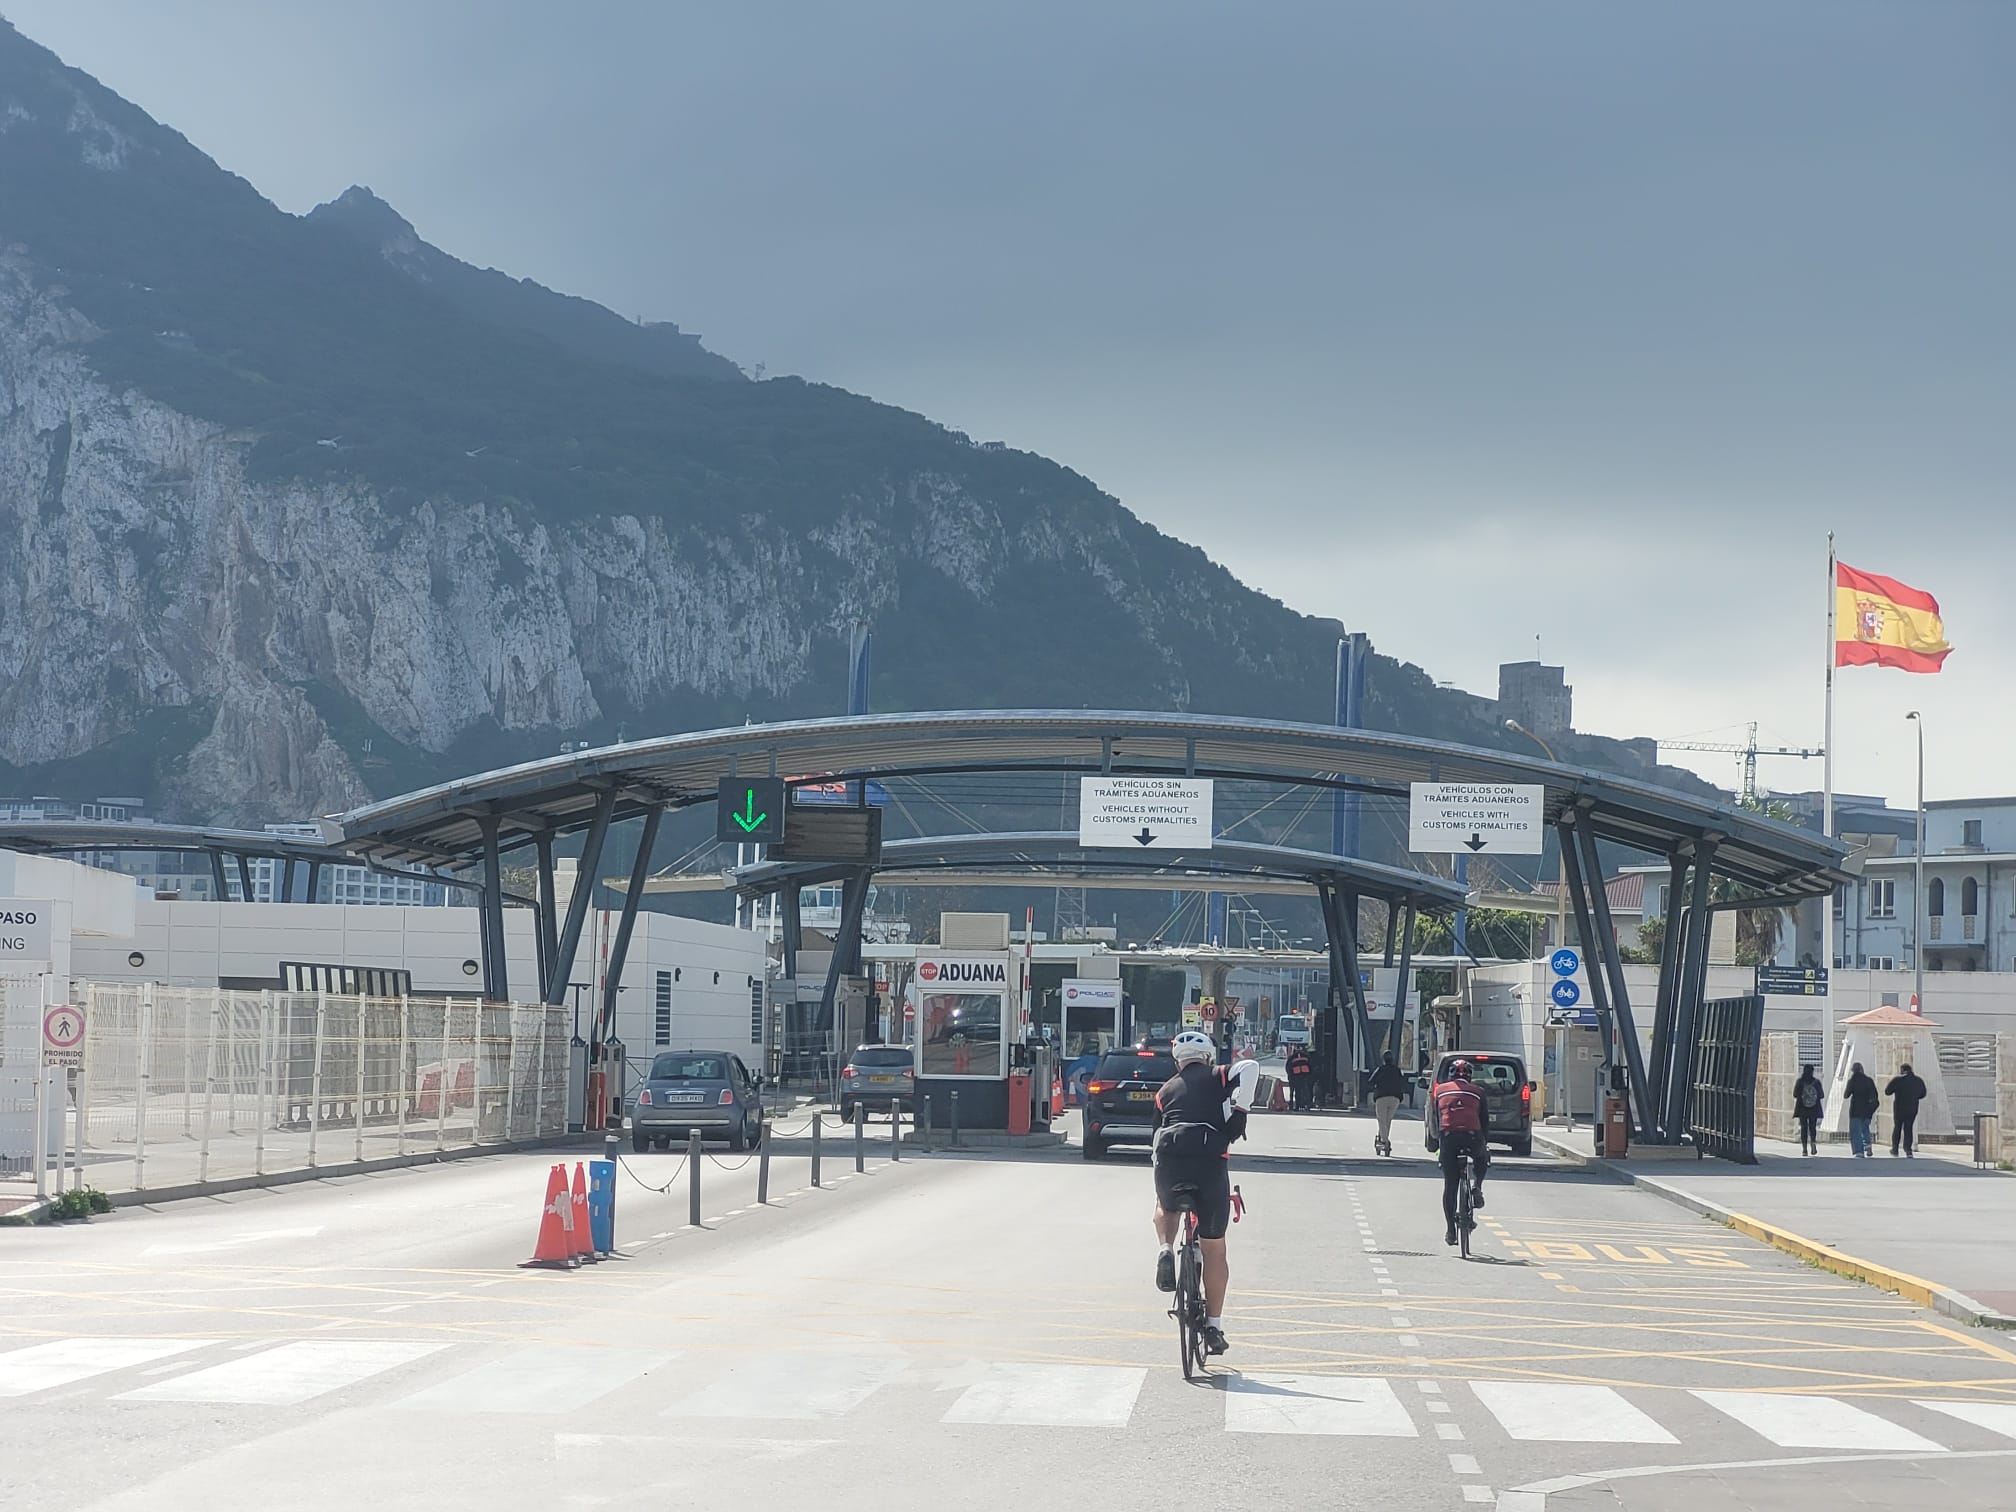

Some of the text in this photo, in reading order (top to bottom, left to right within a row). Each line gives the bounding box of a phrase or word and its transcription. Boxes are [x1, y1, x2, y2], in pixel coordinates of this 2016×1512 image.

[1112, 780, 1164, 788] VEHÍCULOS
[1141, 790, 1199, 798] ADUANEROS
[1439, 785, 1491, 794] VEHÍCULOS
[1471, 796, 1529, 804] ADUANEROS
[1102, 805, 1145, 813] VEHICLES
[1440, 810, 1510, 819] VEHICLES WITH
[1092, 815, 1198, 824] CUSTOMS FORMALITIES
[1422, 821, 1528, 830] CUSTOMS FORMALITIES
[920, 967, 937, 975] STOP
[938, 963, 1006, 982] ADUANA
[1205, 1007, 1215, 1017] 10
[1523, 1241, 1751, 1268] BUS
